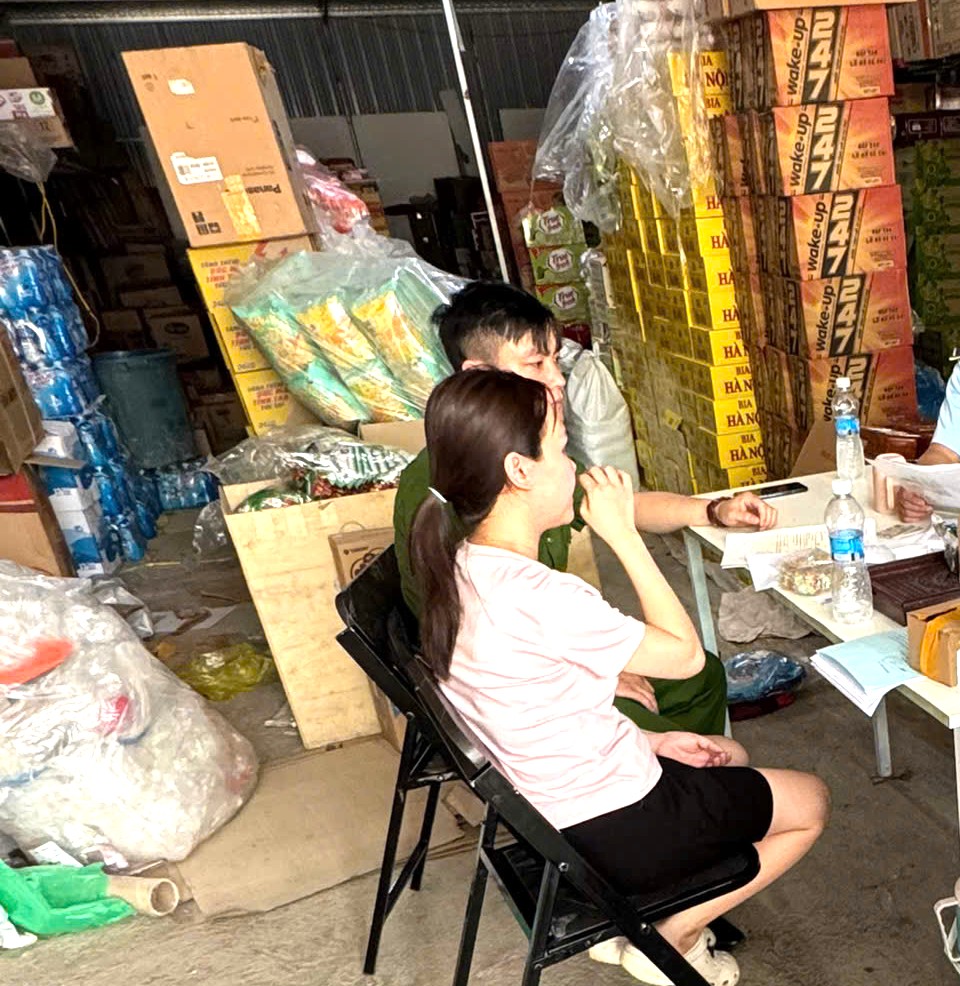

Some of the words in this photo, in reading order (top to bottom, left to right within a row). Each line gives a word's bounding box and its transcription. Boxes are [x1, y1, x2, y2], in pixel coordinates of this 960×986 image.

[787, 17, 808, 95] wake-up
[808, 10, 836, 99] 247
[789, 111, 812, 187] wake-up
[811, 106, 839, 191] 247
[807, 200, 829, 272] wake-up
[827, 194, 854, 275] 247
[816, 285, 837, 352] wake-up
[834, 278, 861, 354] 247
[723, 342, 742, 359] HÀ
[736, 366, 752, 375] BIA
[725, 377, 742, 394] HÀ
[727, 410, 745, 427] HÀ
[738, 399, 752, 409] BIA
[730, 445, 748, 461] HÀ
[741, 434, 756, 444] BIA
